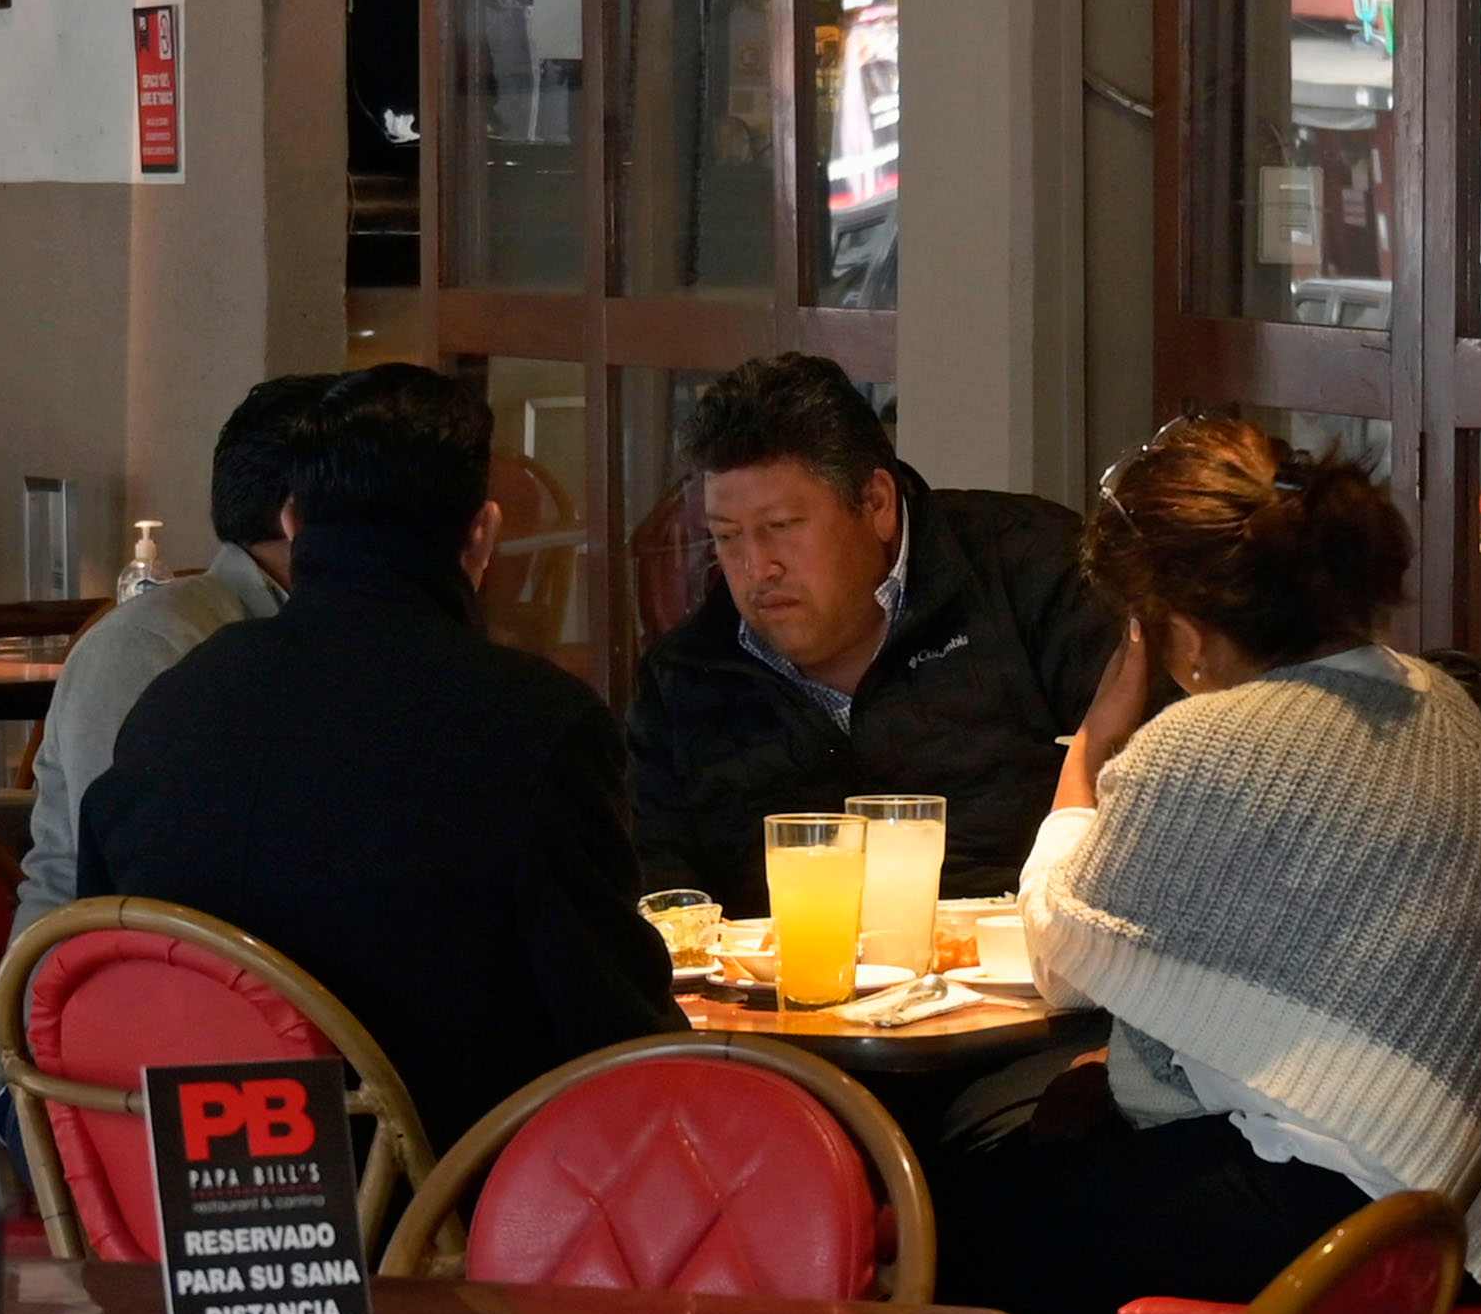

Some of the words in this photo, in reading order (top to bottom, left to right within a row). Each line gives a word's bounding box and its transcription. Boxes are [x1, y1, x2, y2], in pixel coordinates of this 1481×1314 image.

[178, 1077, 317, 1162] PB
[188, 1167, 240, 1189] PAPA
[252, 1162, 321, 1186] BILL'S
[184, 1222, 336, 1257] RESERVADO
[176, 1267, 245, 1297] PARA
[249, 1263, 286, 1293] SU
[290, 1257, 362, 1289] SANA
